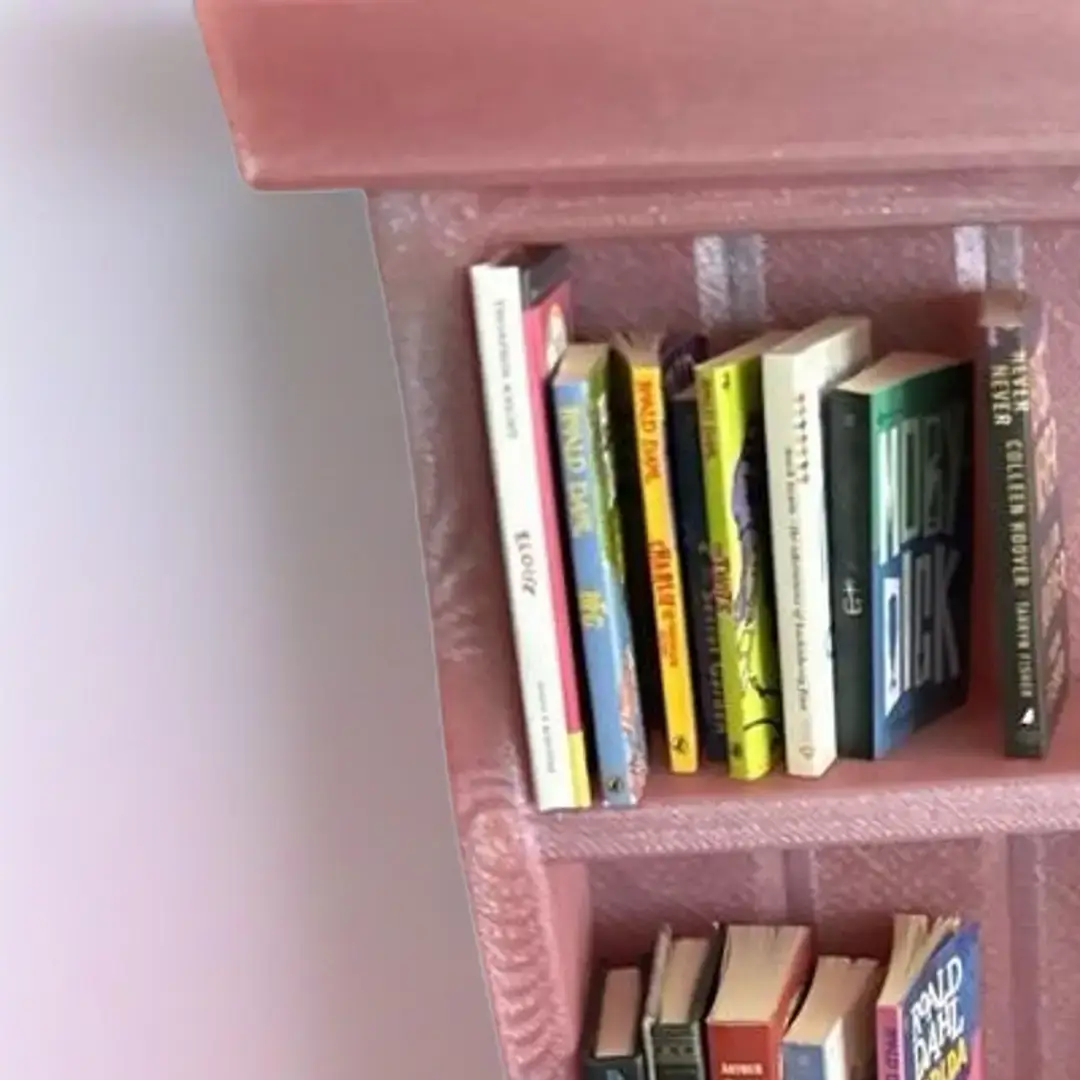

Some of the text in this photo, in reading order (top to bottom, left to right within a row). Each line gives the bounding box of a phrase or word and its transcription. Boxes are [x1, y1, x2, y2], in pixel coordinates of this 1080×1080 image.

[989, 365, 1012, 425] NEVER
[1006, 439, 1031, 587] COLLEEN HOOVER
[883, 541, 961, 717] DICK
[910, 956, 964, 1042] ROALD
